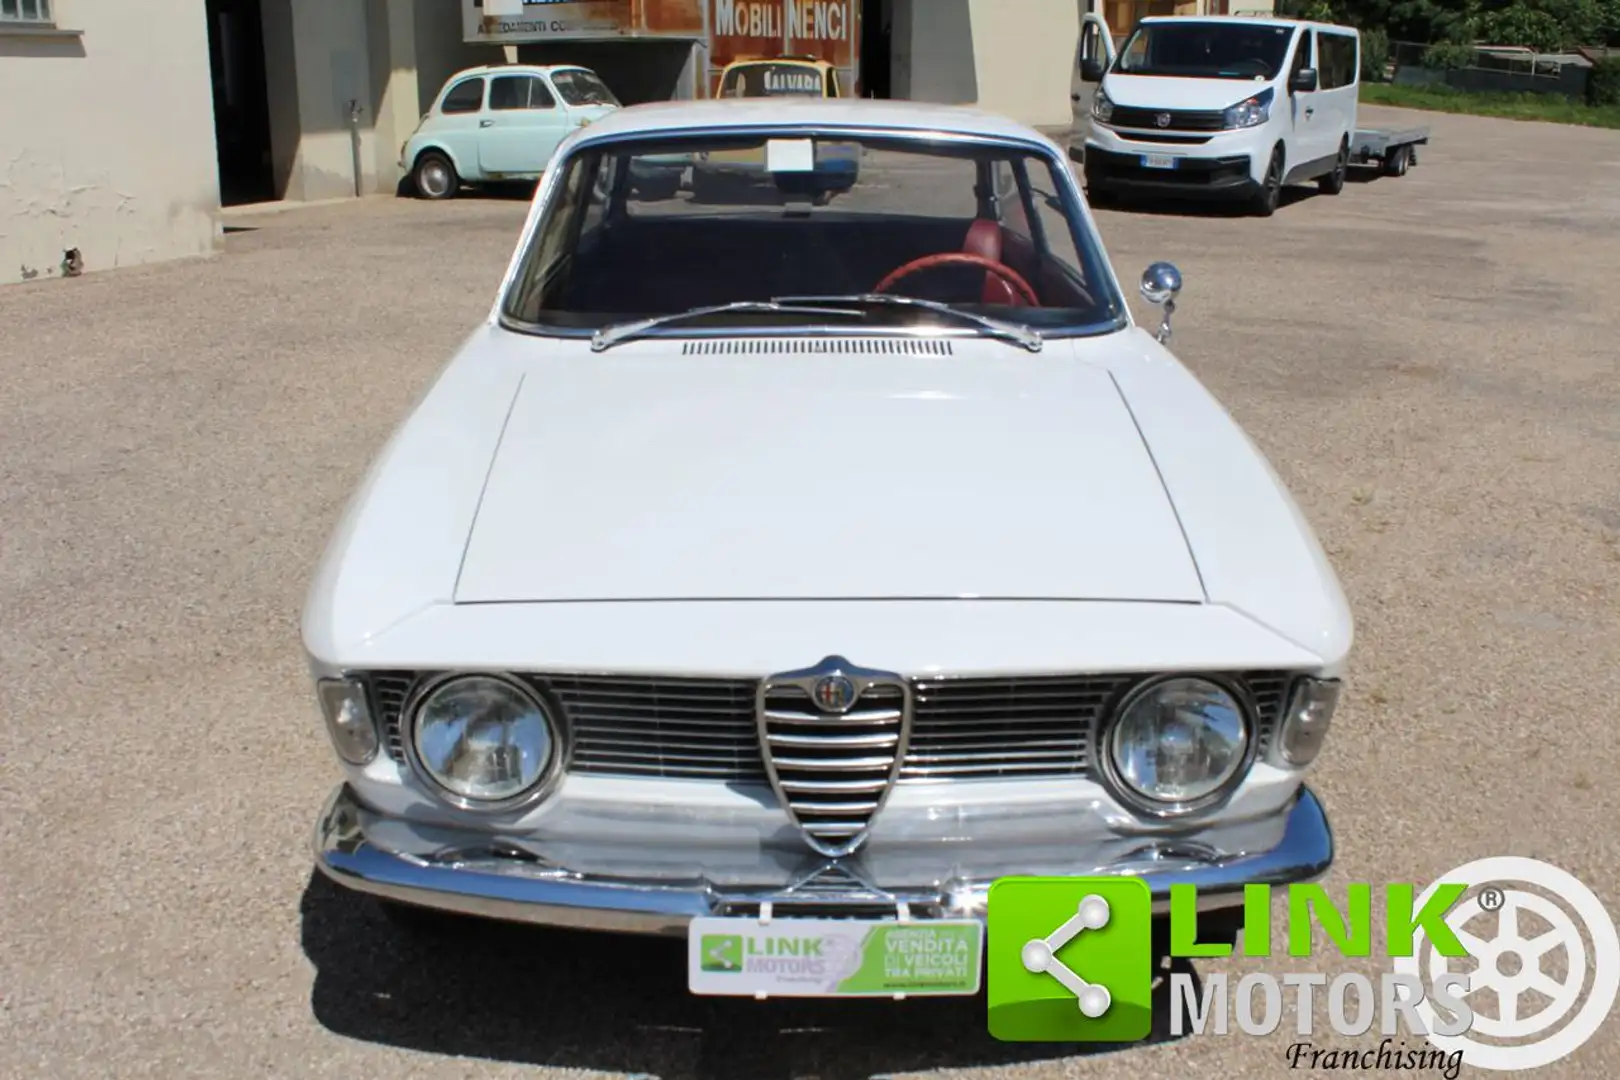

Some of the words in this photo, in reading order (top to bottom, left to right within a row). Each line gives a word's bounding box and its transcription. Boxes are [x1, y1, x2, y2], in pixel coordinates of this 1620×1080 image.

[716, 0, 781, 37] MOBILI
[789, 1, 847, 41] NENCI
[747, 937, 824, 955] LINK
[885, 938, 968, 953] VENDITA
[747, 957, 826, 974] MOTORS
[904, 953, 968, 967] VEICOLI
